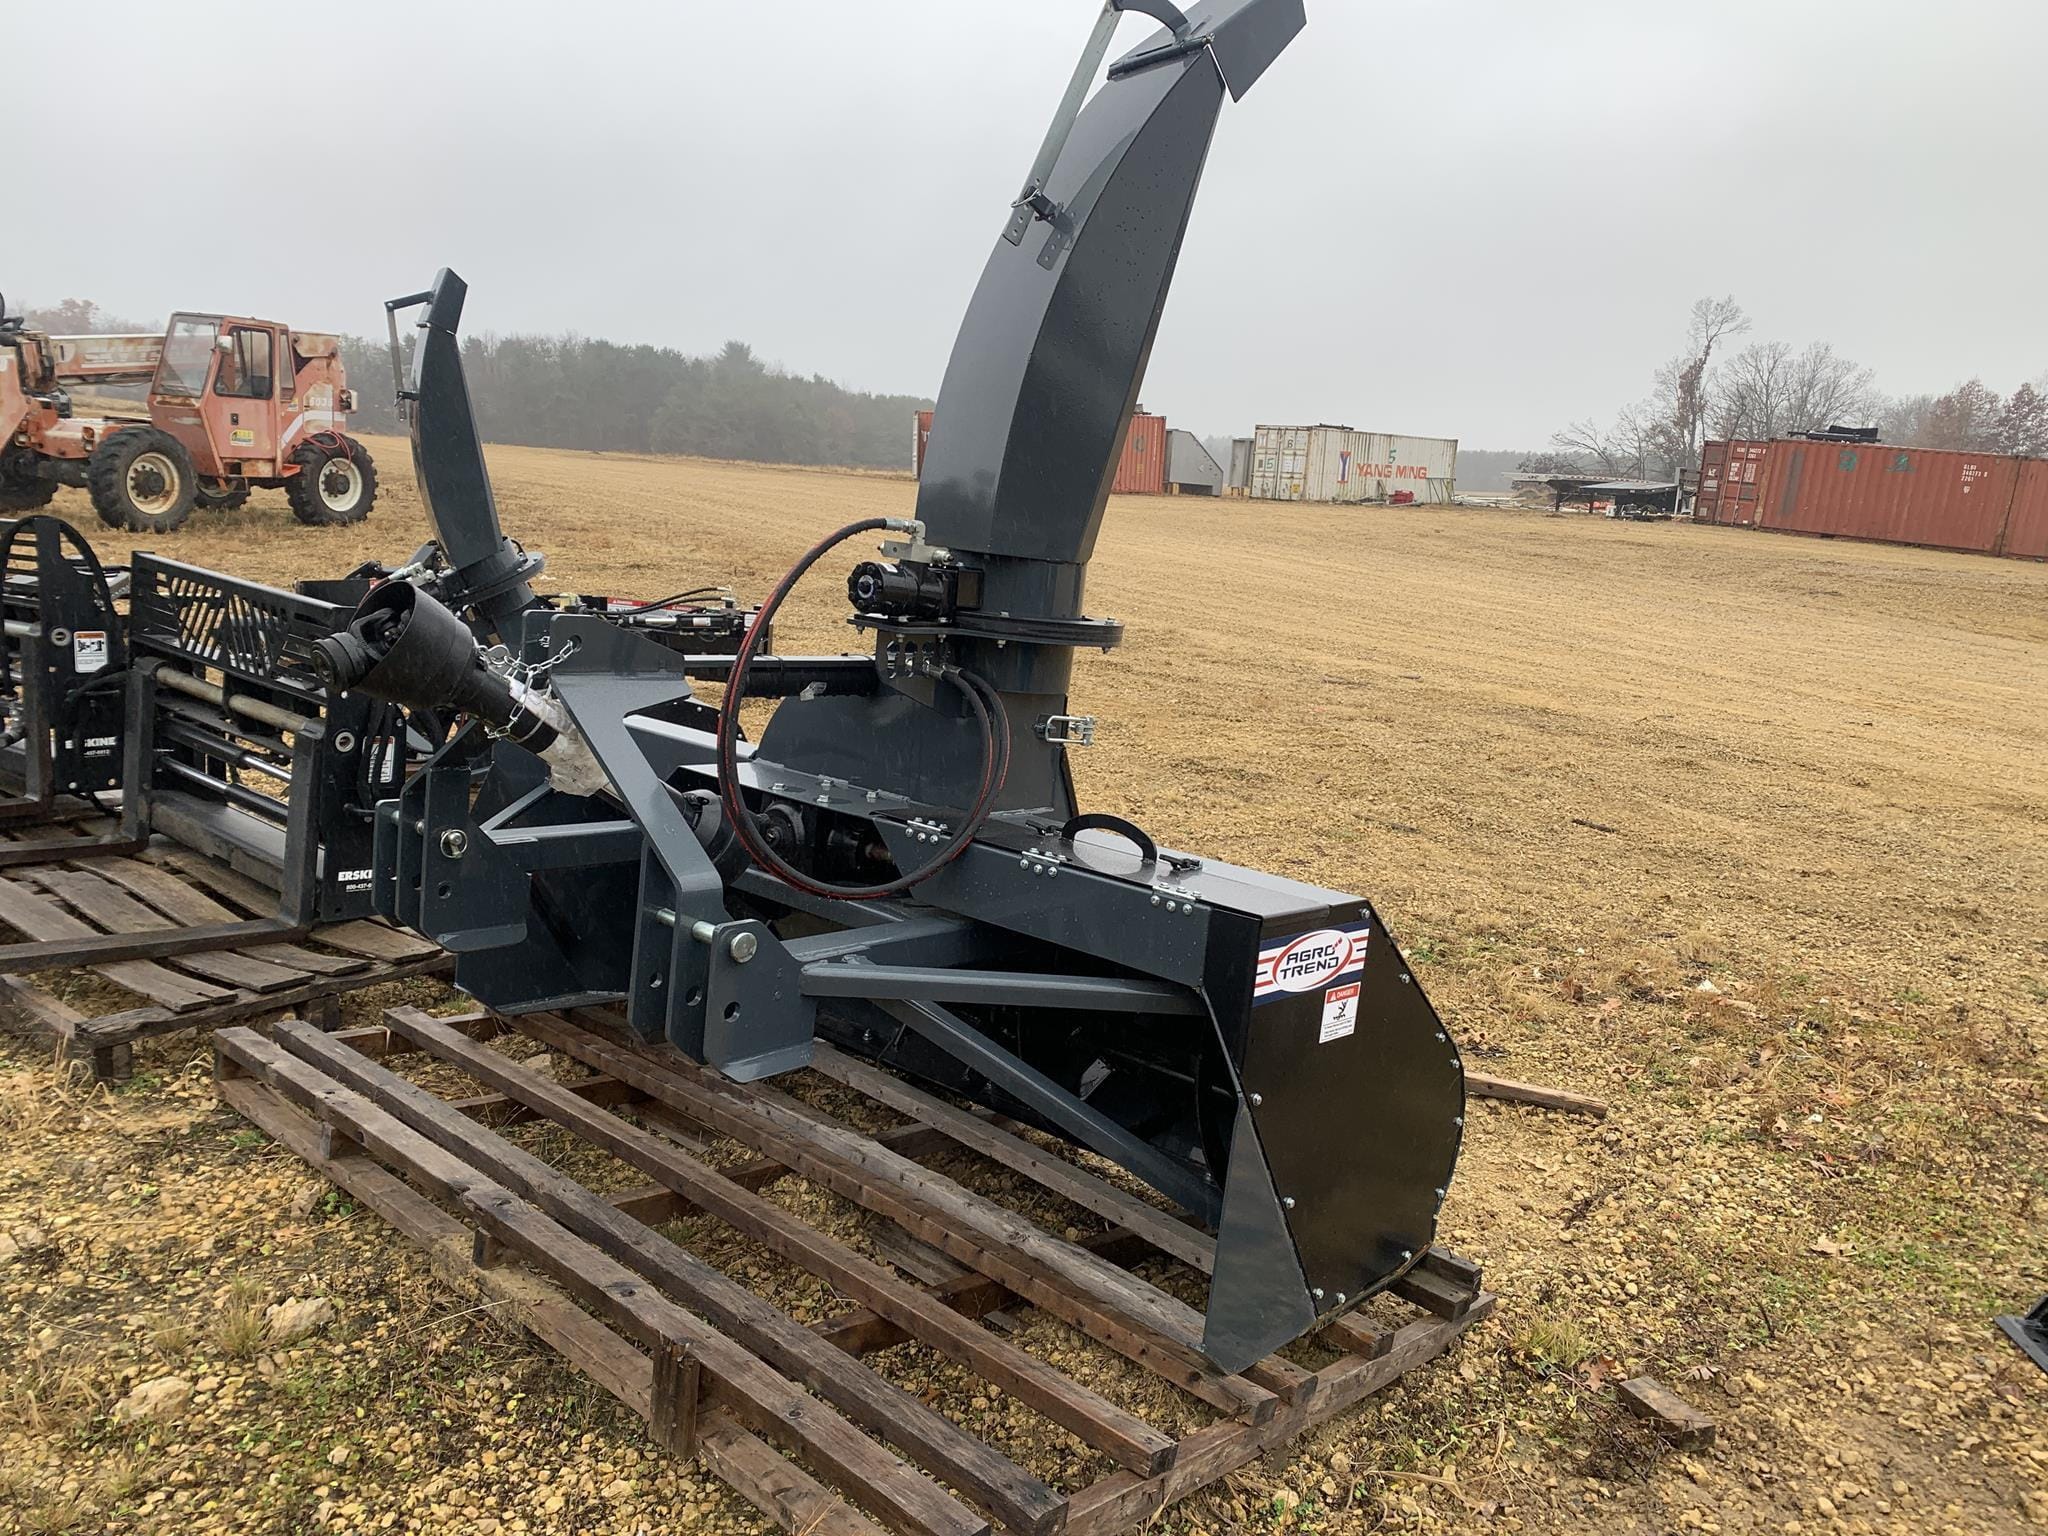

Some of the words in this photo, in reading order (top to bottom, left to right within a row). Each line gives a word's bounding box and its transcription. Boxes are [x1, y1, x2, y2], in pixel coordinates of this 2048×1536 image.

[1266, 457, 1274, 469] 5
[1389, 448, 1397, 464] 5
[1356, 463, 1392, 478] YANG
[1395, 464, 1428, 480] MING
[64, 735, 117, 749] EKINE
[337, 869, 373, 882] ERSKI
[1286, 943, 1336, 966] AGRO
[1279, 956, 1340, 980] TREND
[1336, 987, 1355, 1000] DANGER
